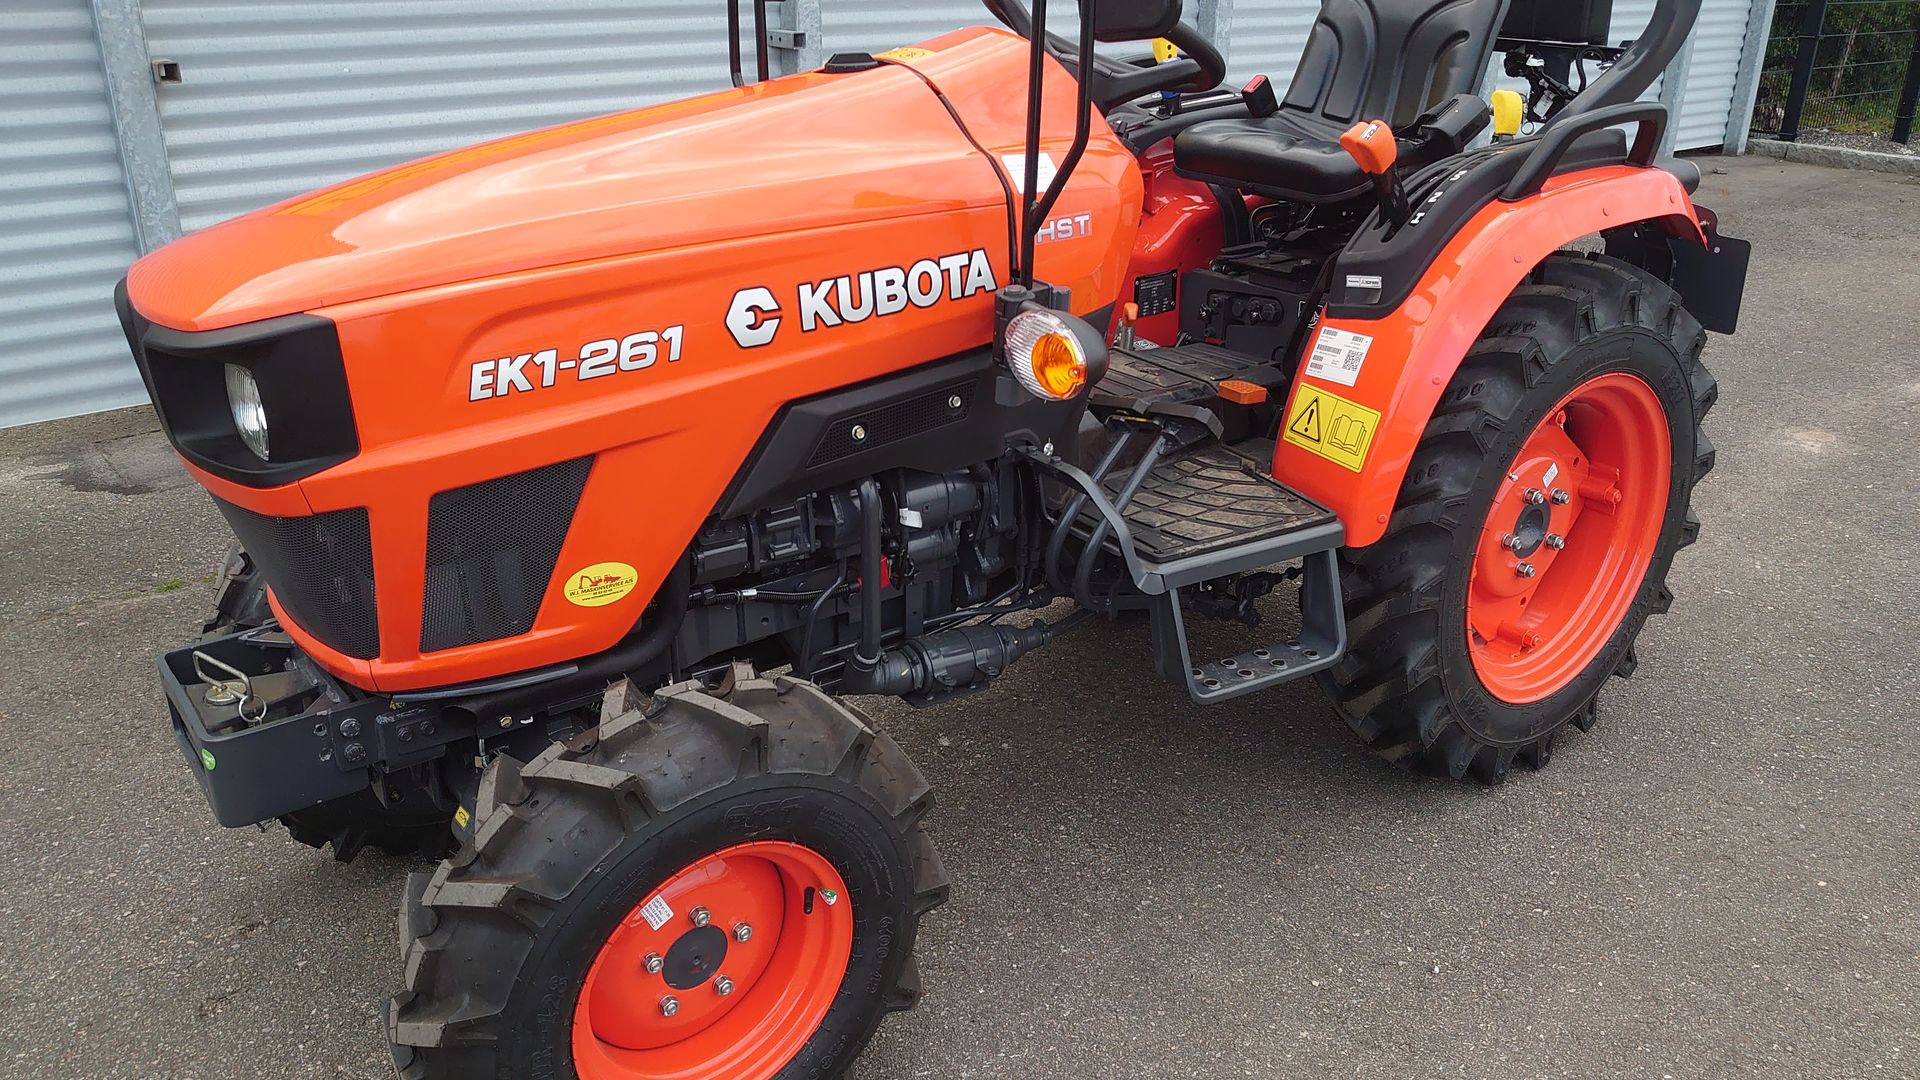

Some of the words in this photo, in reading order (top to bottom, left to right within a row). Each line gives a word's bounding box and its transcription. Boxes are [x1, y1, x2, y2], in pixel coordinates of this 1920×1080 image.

[1036, 213, 1090, 243] HST
[798, 248, 997, 333] KUBOTA
[469, 324, 685, 402] EK1-261
[581, 580, 624, 594] MASKINSERVICE
